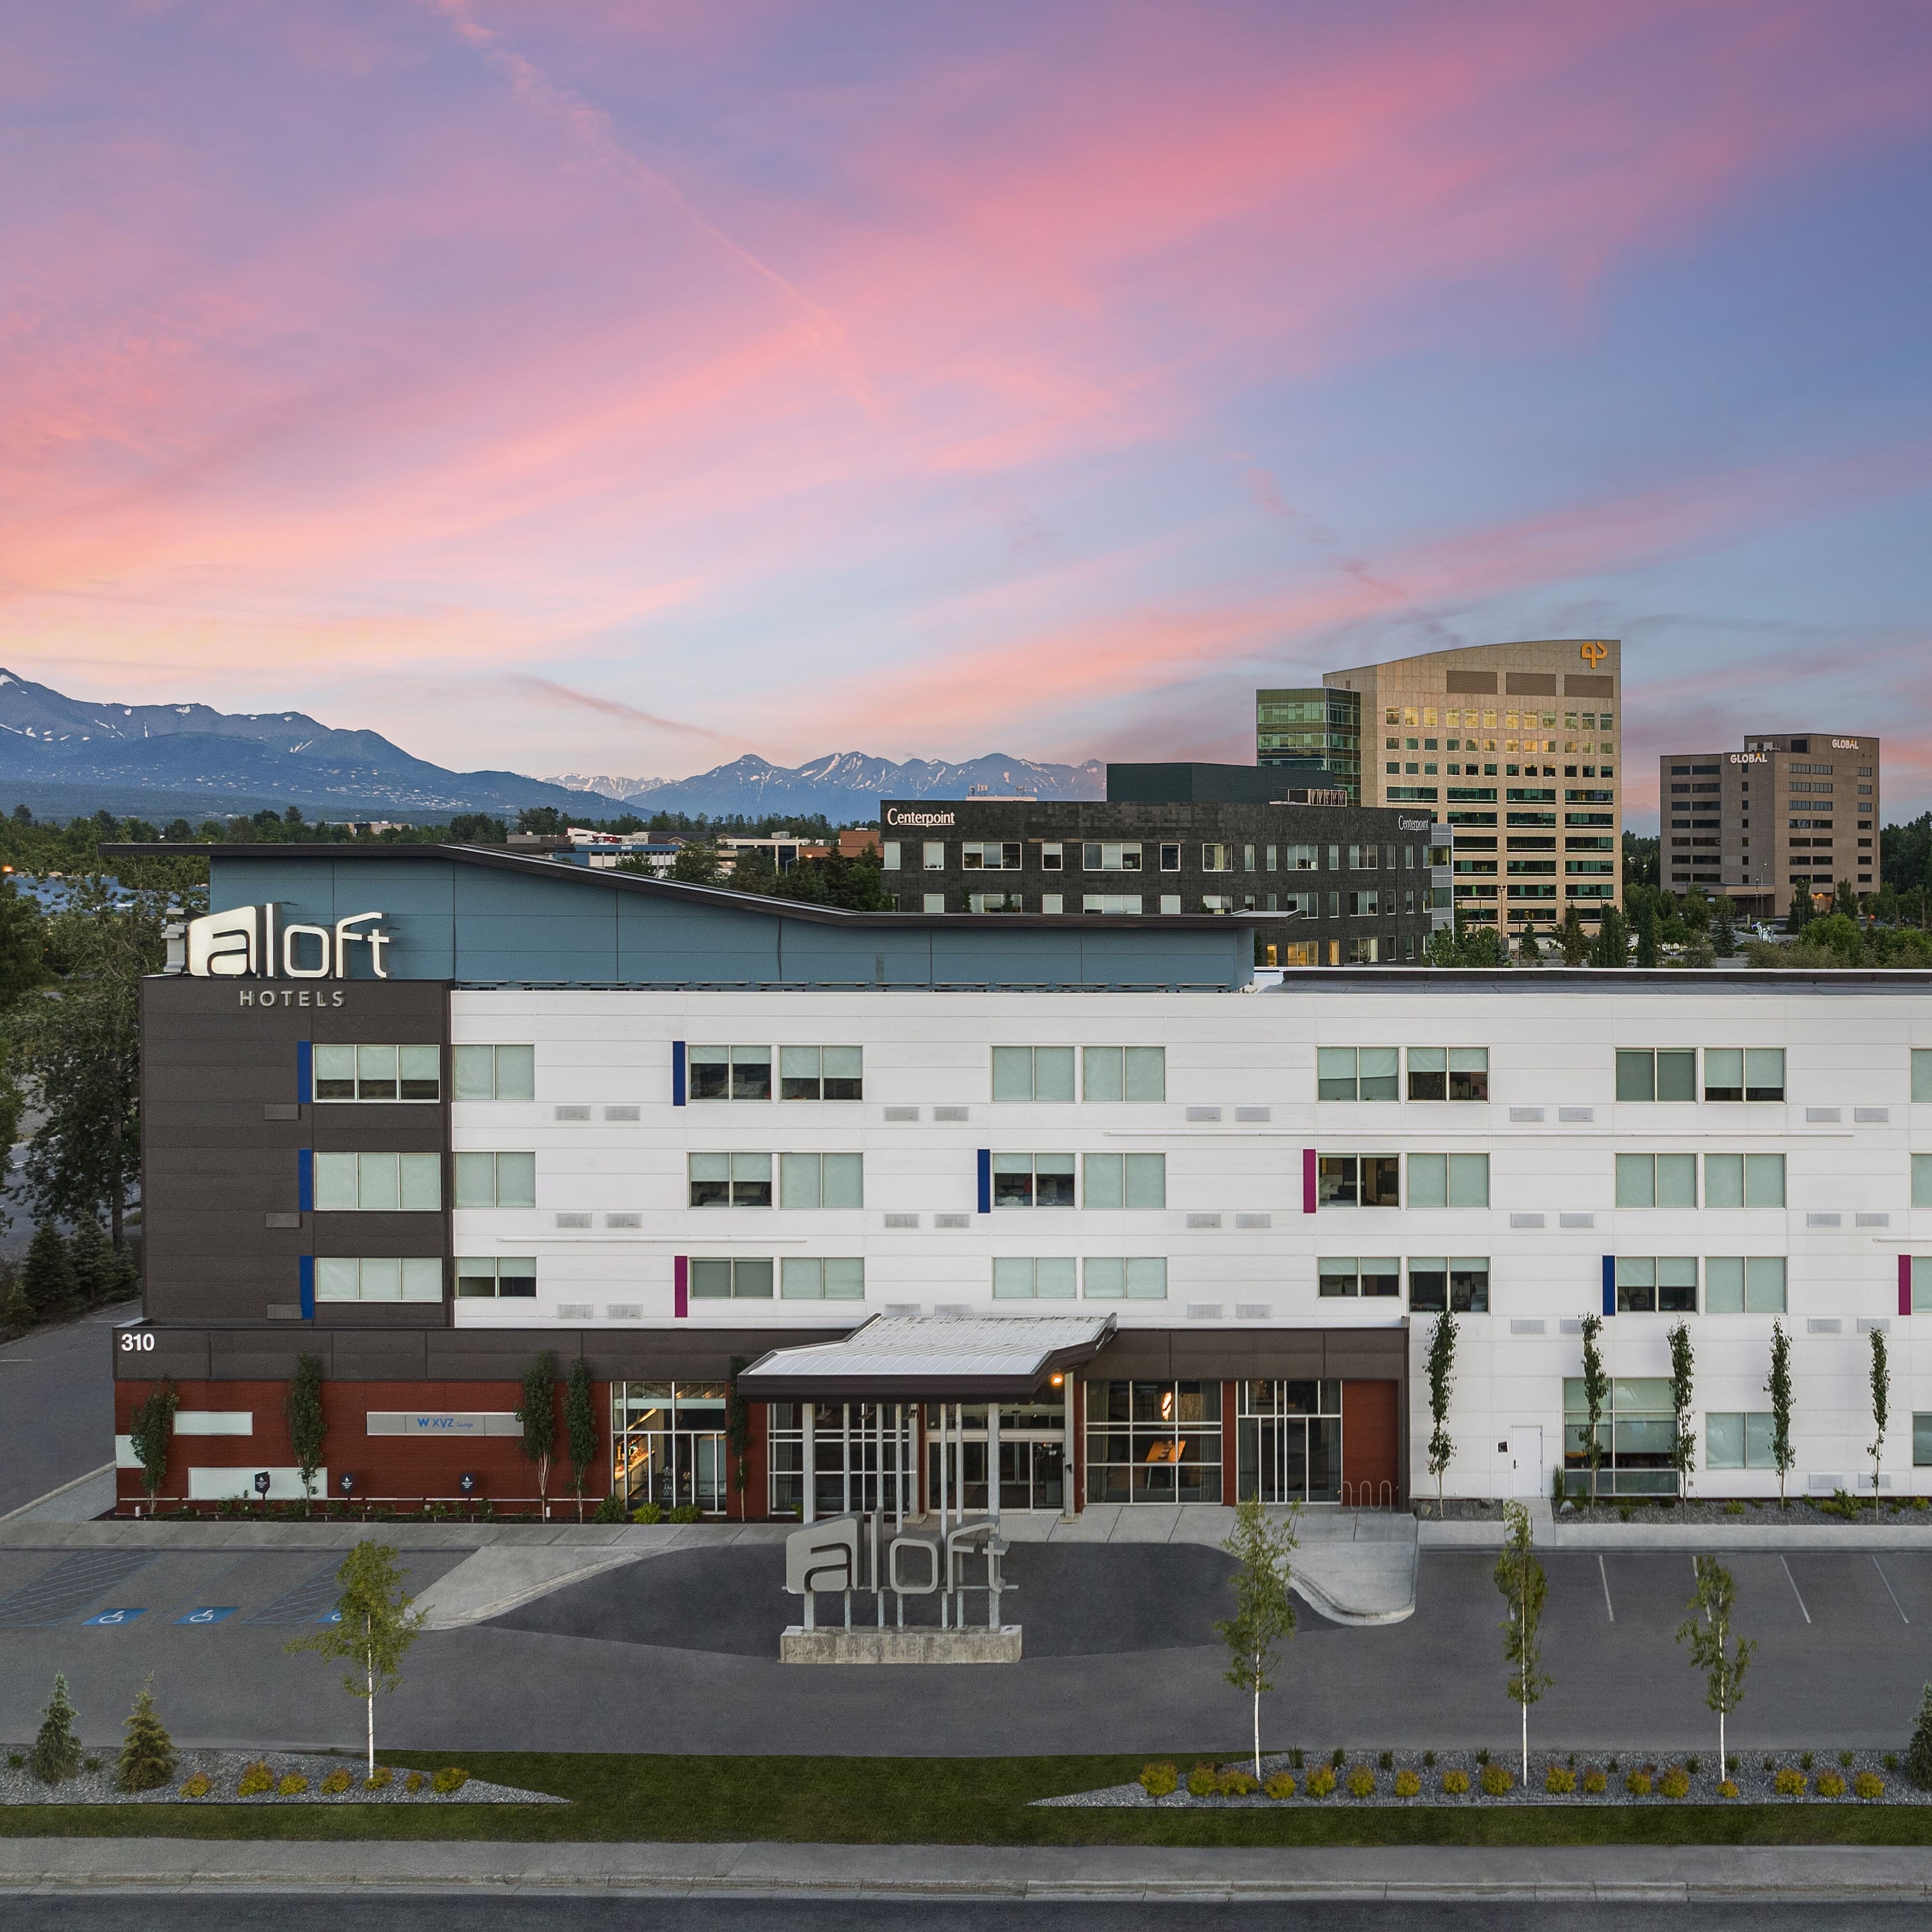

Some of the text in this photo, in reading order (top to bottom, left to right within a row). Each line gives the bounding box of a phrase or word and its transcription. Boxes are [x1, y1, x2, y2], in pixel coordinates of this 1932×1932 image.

[1832, 739, 1859, 749] GLOBAL
[1730, 753, 1768, 764] GLOBAL
[887, 808, 955, 828] Centerpoint
[1398, 815, 1429, 832] Centerpoint
[189, 903, 390, 978] aloft
[239, 990, 346, 1007] HOTELS
[121, 1333, 154, 1351] 310
[786, 1509, 1008, 1594] aloft
[846, 1639, 953, 1658] HOTELS
